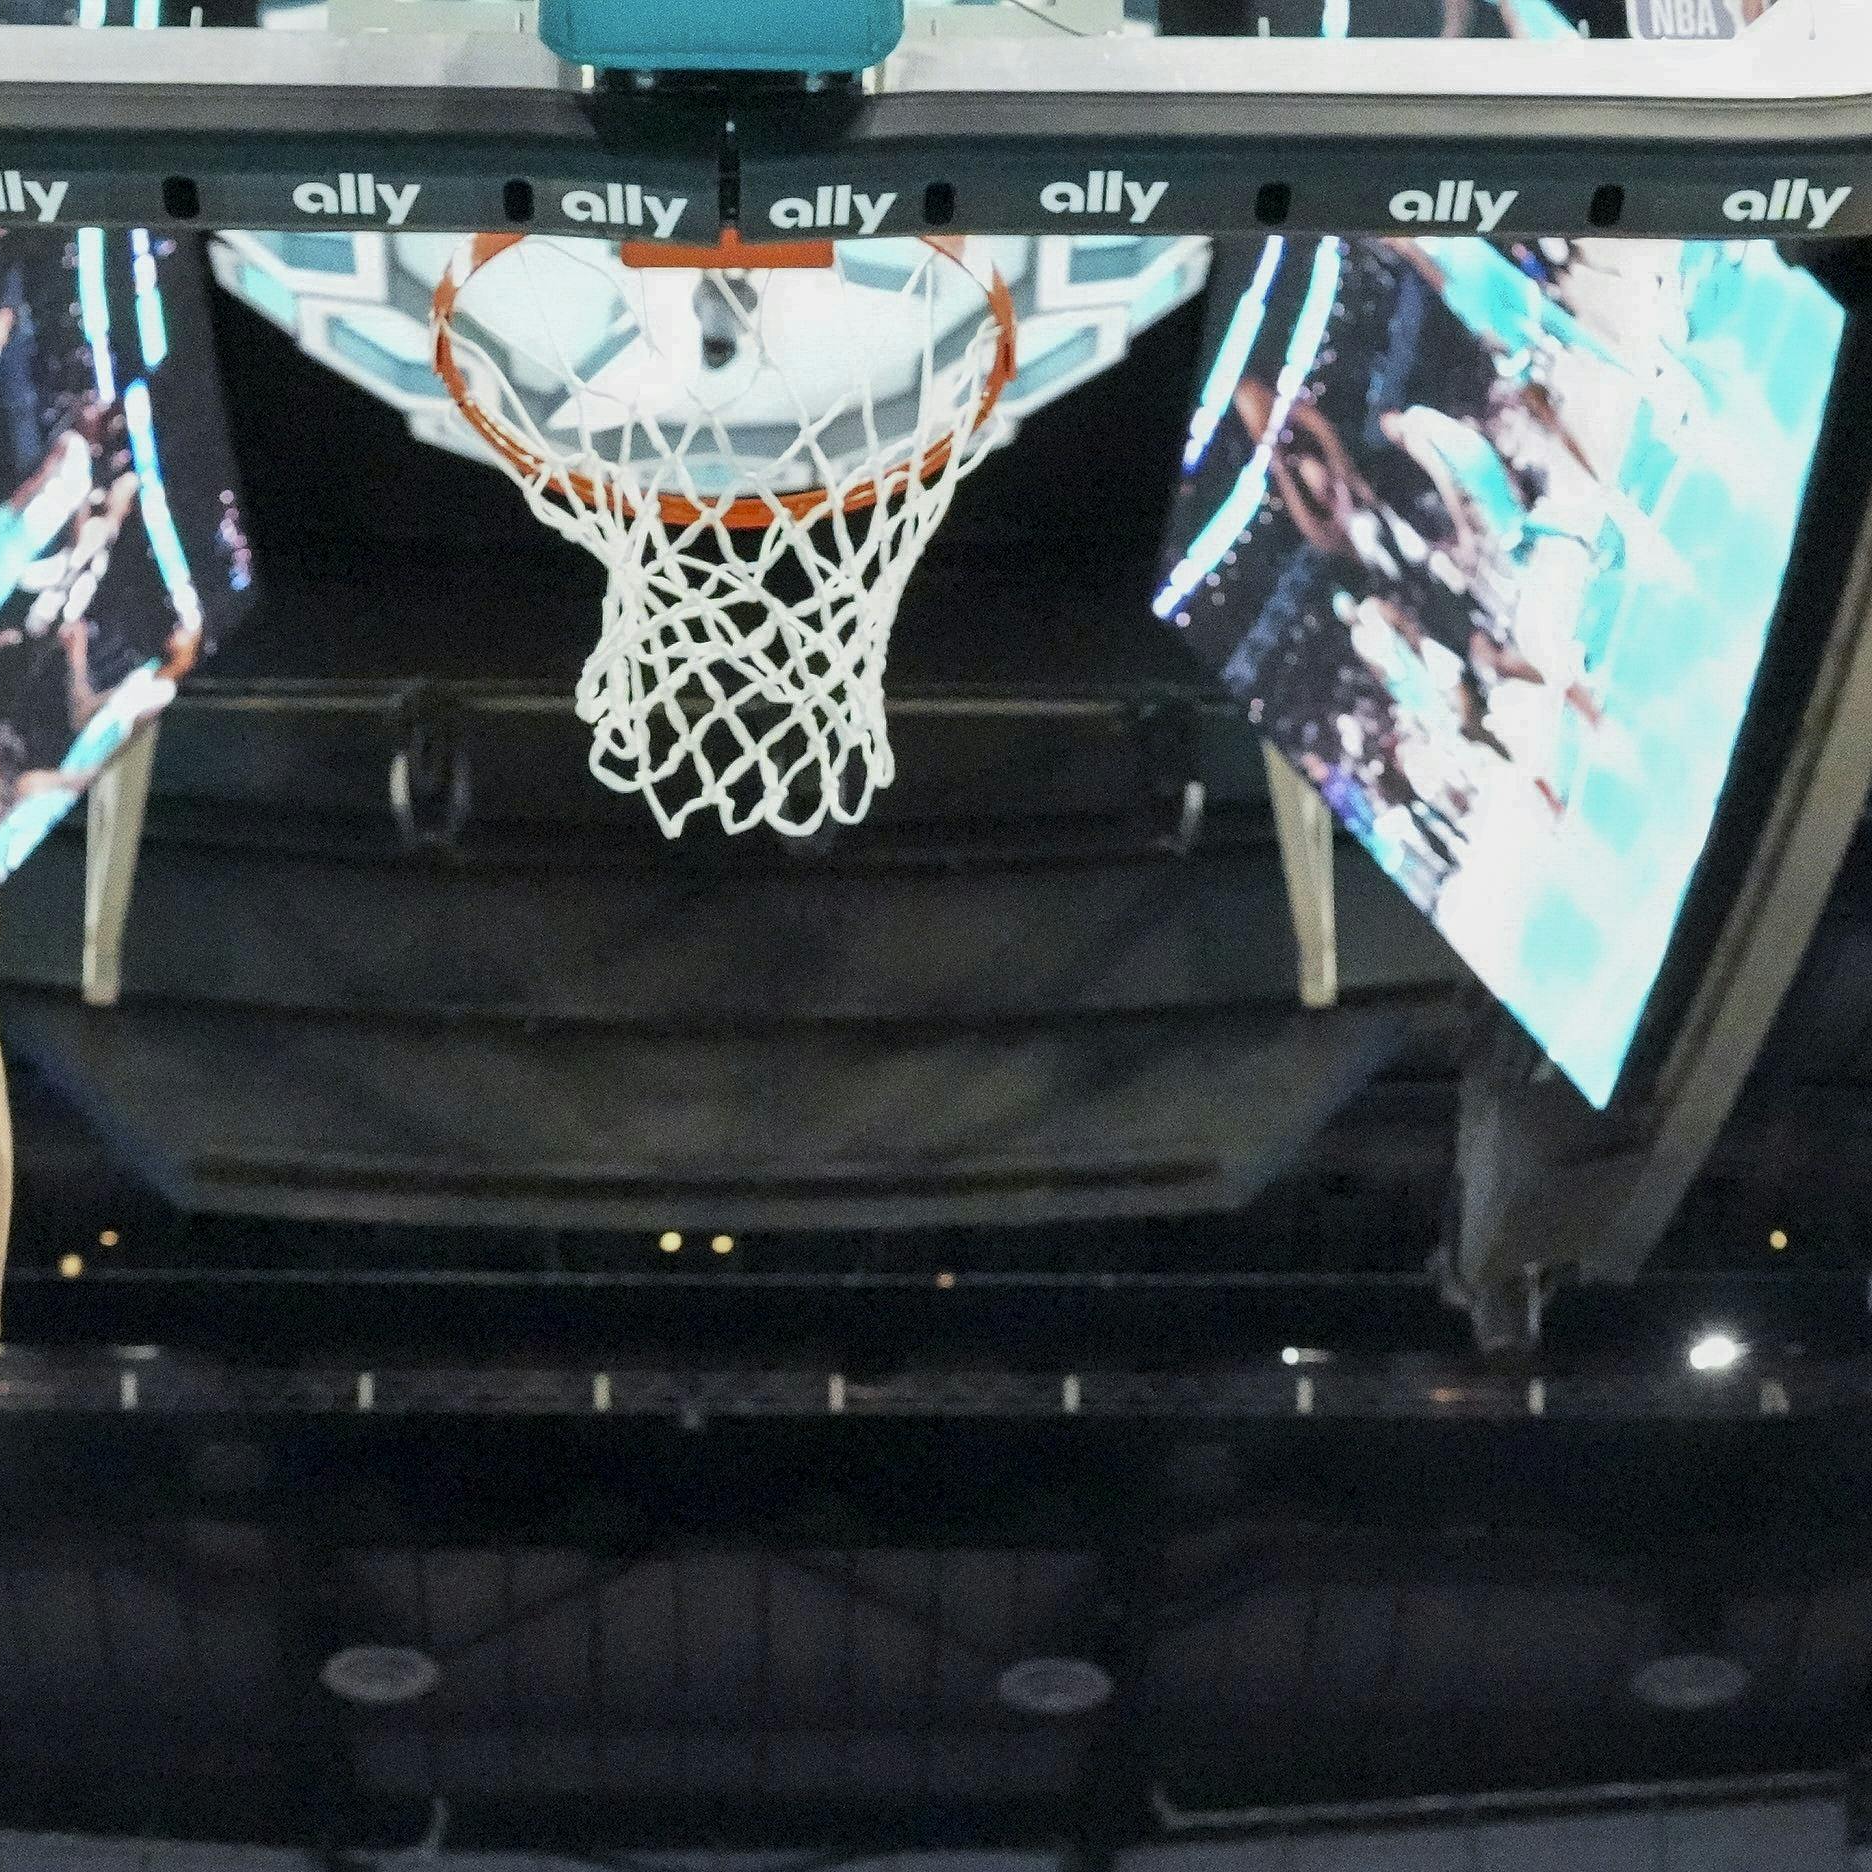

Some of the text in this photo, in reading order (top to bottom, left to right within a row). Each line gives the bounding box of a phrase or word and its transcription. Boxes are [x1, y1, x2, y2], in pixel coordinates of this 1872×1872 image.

[291, 172, 420, 225] ally
[560, 182, 688, 238] ally
[768, 184, 897, 236] ally
[1039, 170, 1169, 224] ally
[1388, 180, 1518, 232] ally
[1722, 179, 1852, 229] ally
